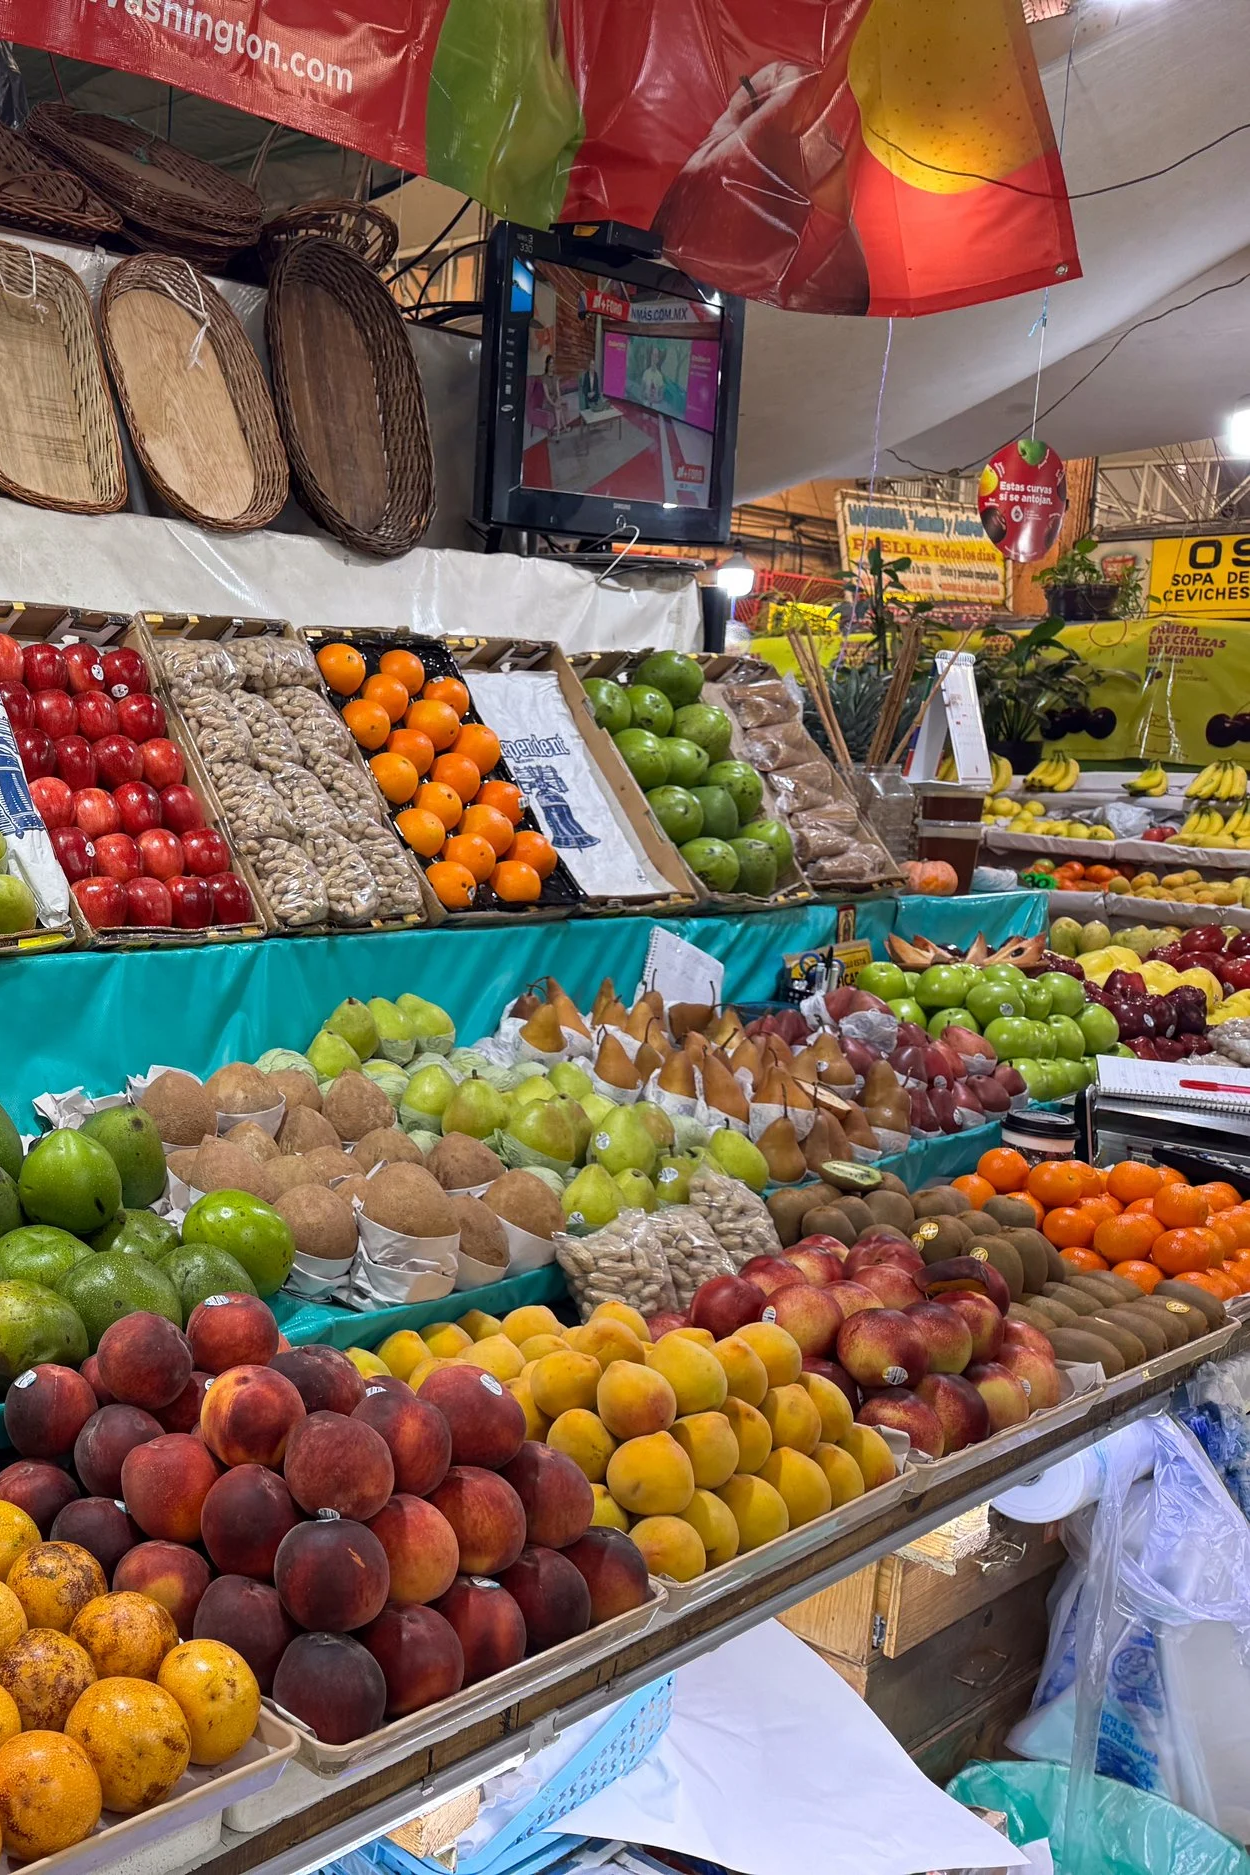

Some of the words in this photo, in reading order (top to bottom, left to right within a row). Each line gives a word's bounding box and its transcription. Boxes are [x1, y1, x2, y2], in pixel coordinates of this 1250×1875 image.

[90, 0, 352, 93] ashington.com
[1000, 481, 1025, 492] Estas
[1026, 486, 1052, 494] curvas
[999, 492, 1008, 501] sí
[1022, 494, 1053, 506] antojan.
[853, 538, 929, 555] PAELLA
[933, 546, 960, 560] Todos
[962, 550, 976, 560] los
[1172, 573, 1214, 586] SOPA
[1228, 571, 1249, 584] DE
[1163, 586, 1250, 602] CEVICHES
[1151, 625, 1198, 636] PRUEBA
[1149, 635, 1171, 645] LAS
[1172, 636, 1227, 648] CEREZAS
[1164, 646, 1214, 658] VERANO
[499, 733, 570, 763] ependent
